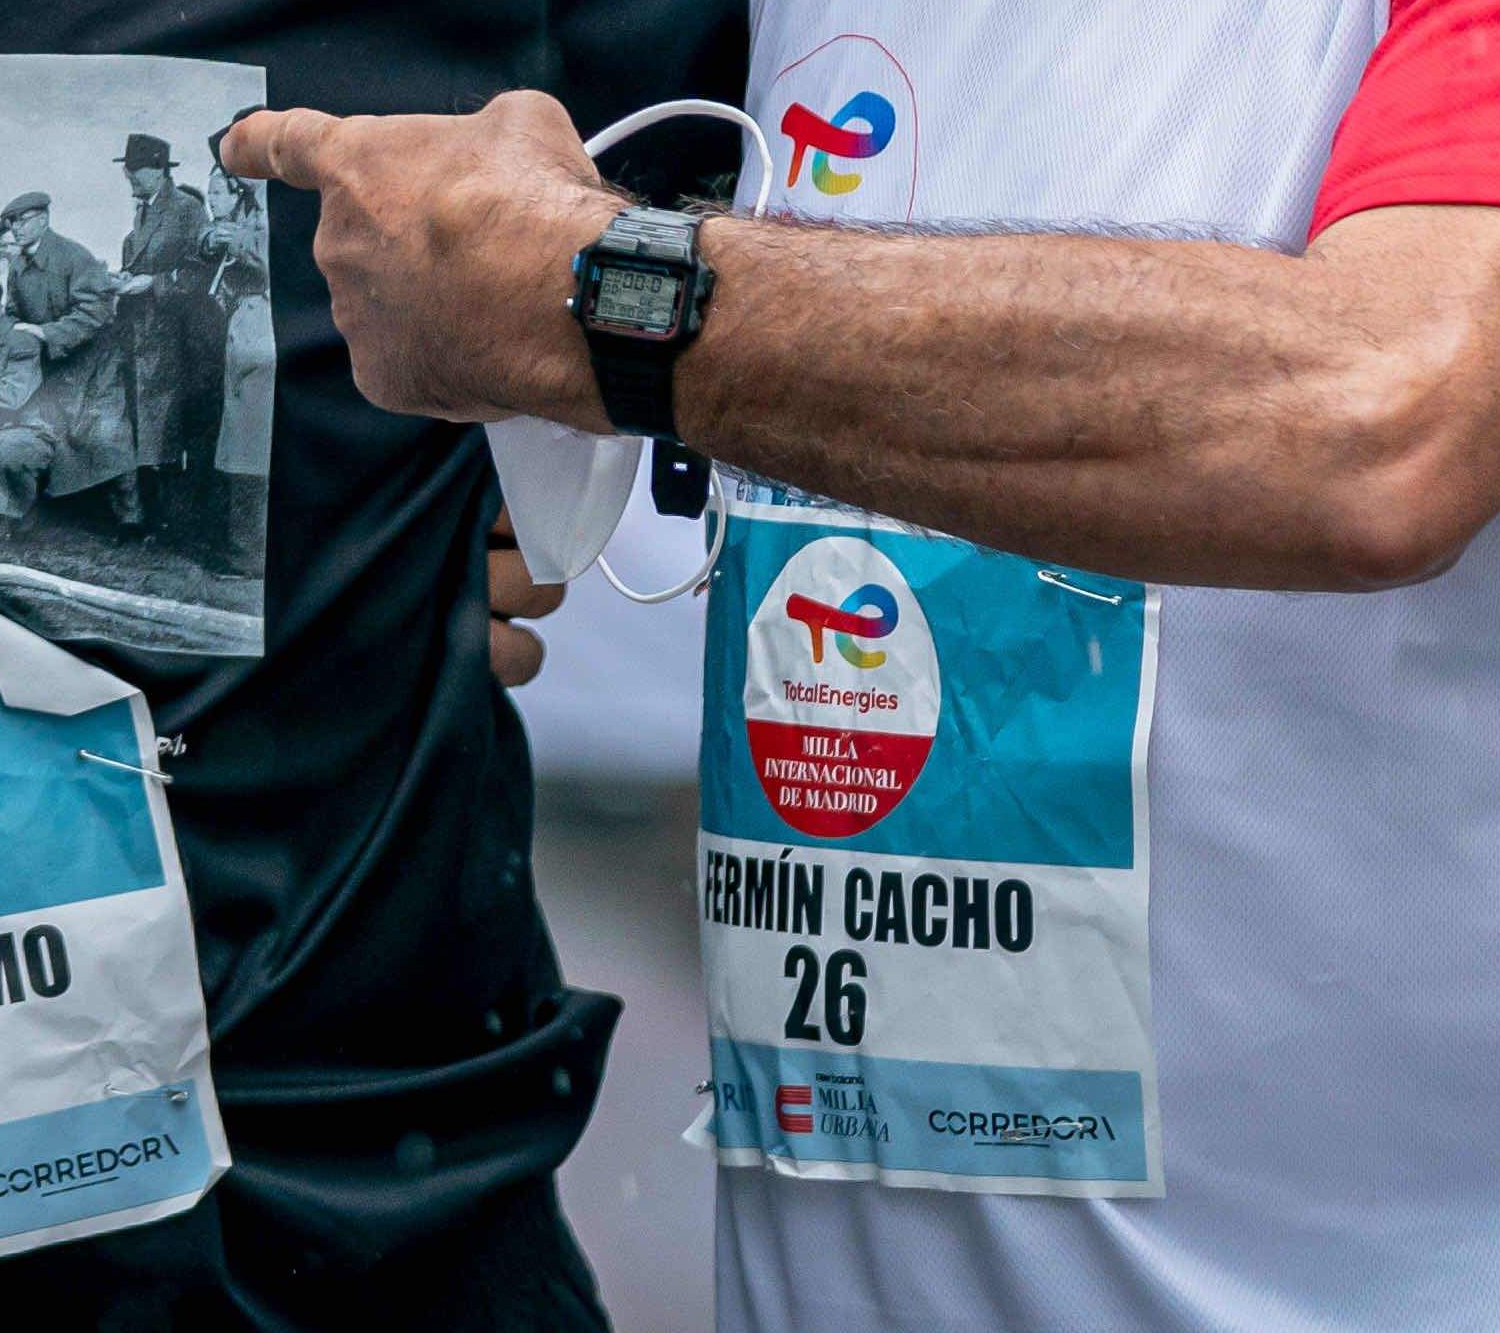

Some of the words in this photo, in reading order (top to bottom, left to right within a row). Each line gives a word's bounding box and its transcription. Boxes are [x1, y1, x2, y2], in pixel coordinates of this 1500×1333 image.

[782, 680, 898, 714] TotalEnergies
[801, 735, 858, 760] MILLA
[779, 785, 801, 807] DE
[805, 788, 878, 814] MADRID
[844, 866, 1034, 953] CACHO
[783, 944, 868, 1047] 26
